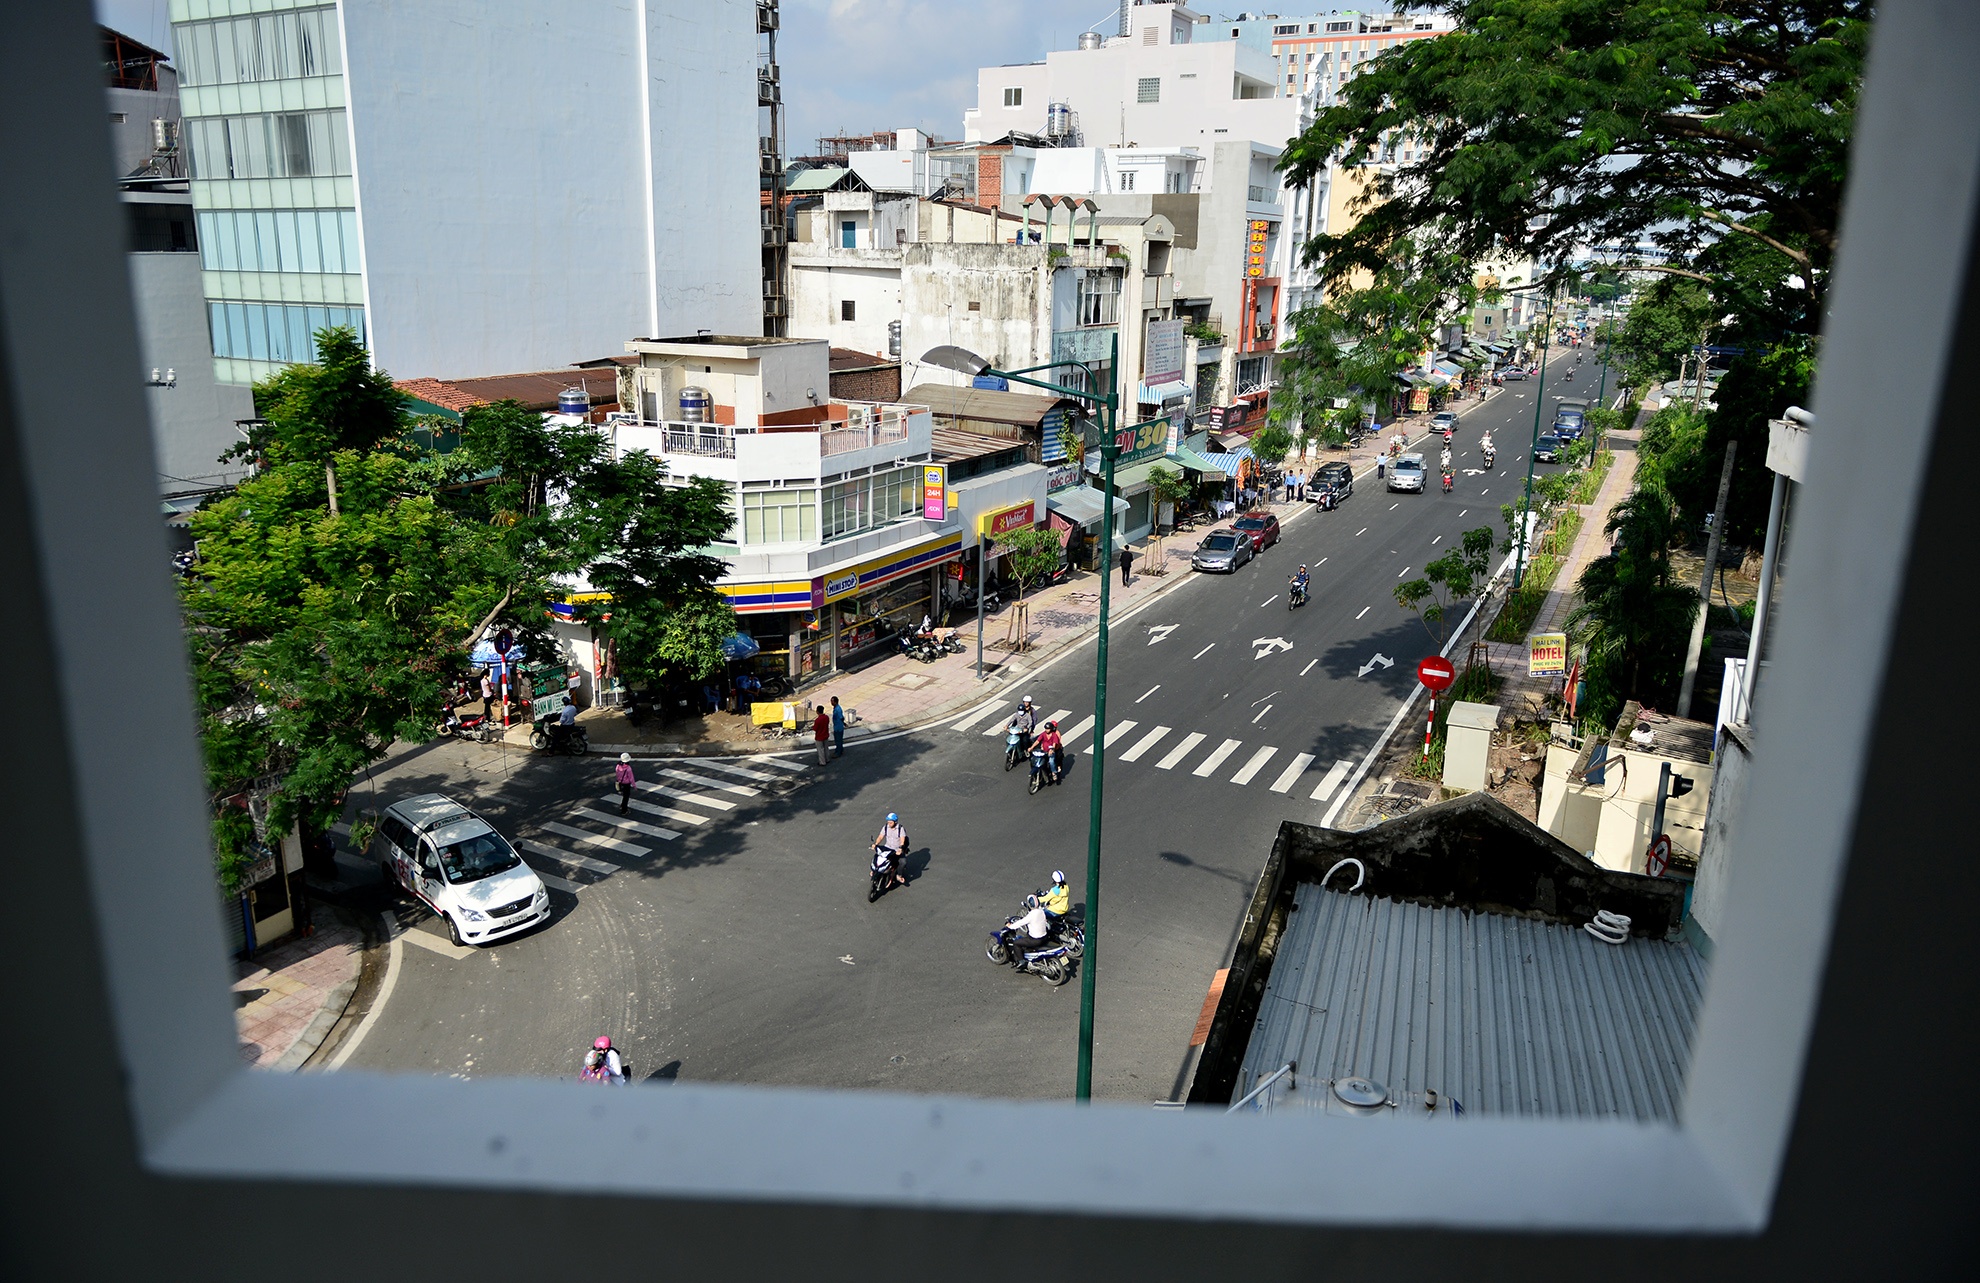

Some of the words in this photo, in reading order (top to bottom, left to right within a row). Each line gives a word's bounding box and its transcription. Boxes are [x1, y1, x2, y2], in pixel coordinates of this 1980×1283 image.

[1136, 421, 1168, 449] 30
[927, 489, 941, 497] 24H
[829, 582, 841, 594] MINI
[841, 577, 855, 589] STOP
[1532, 647, 1563, 660] HOTEL
